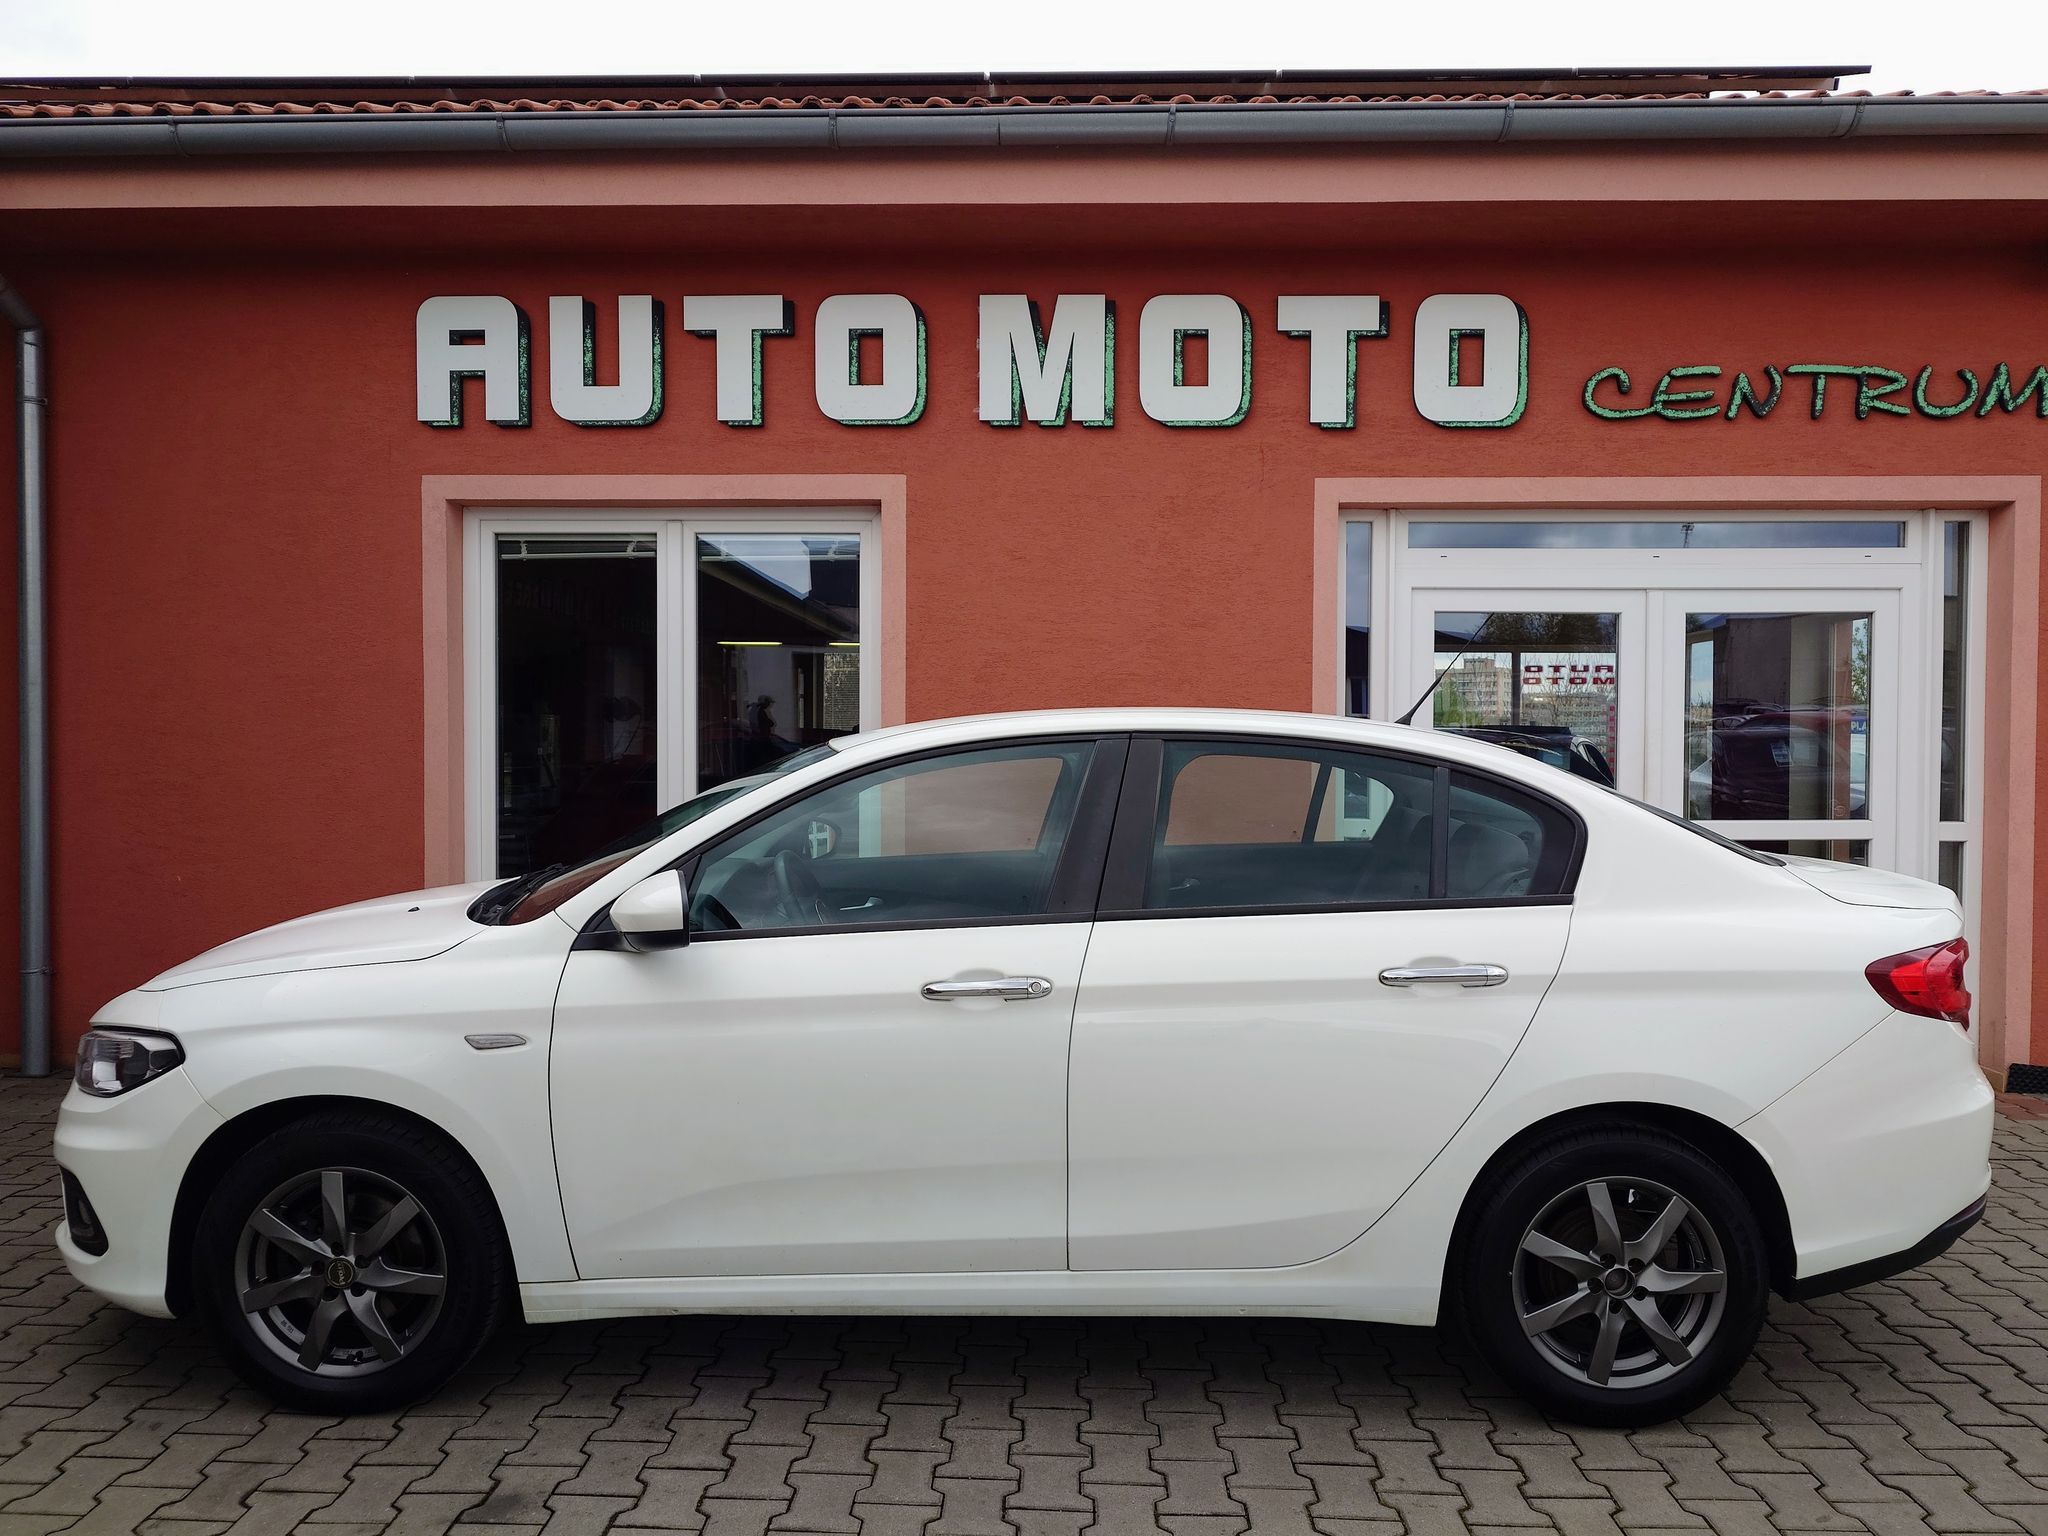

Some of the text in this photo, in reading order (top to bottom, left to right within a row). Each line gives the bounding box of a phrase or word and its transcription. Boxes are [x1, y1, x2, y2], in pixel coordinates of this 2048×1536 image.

[415, 293, 2048, 429] AUTO MOTO CENTRUM
